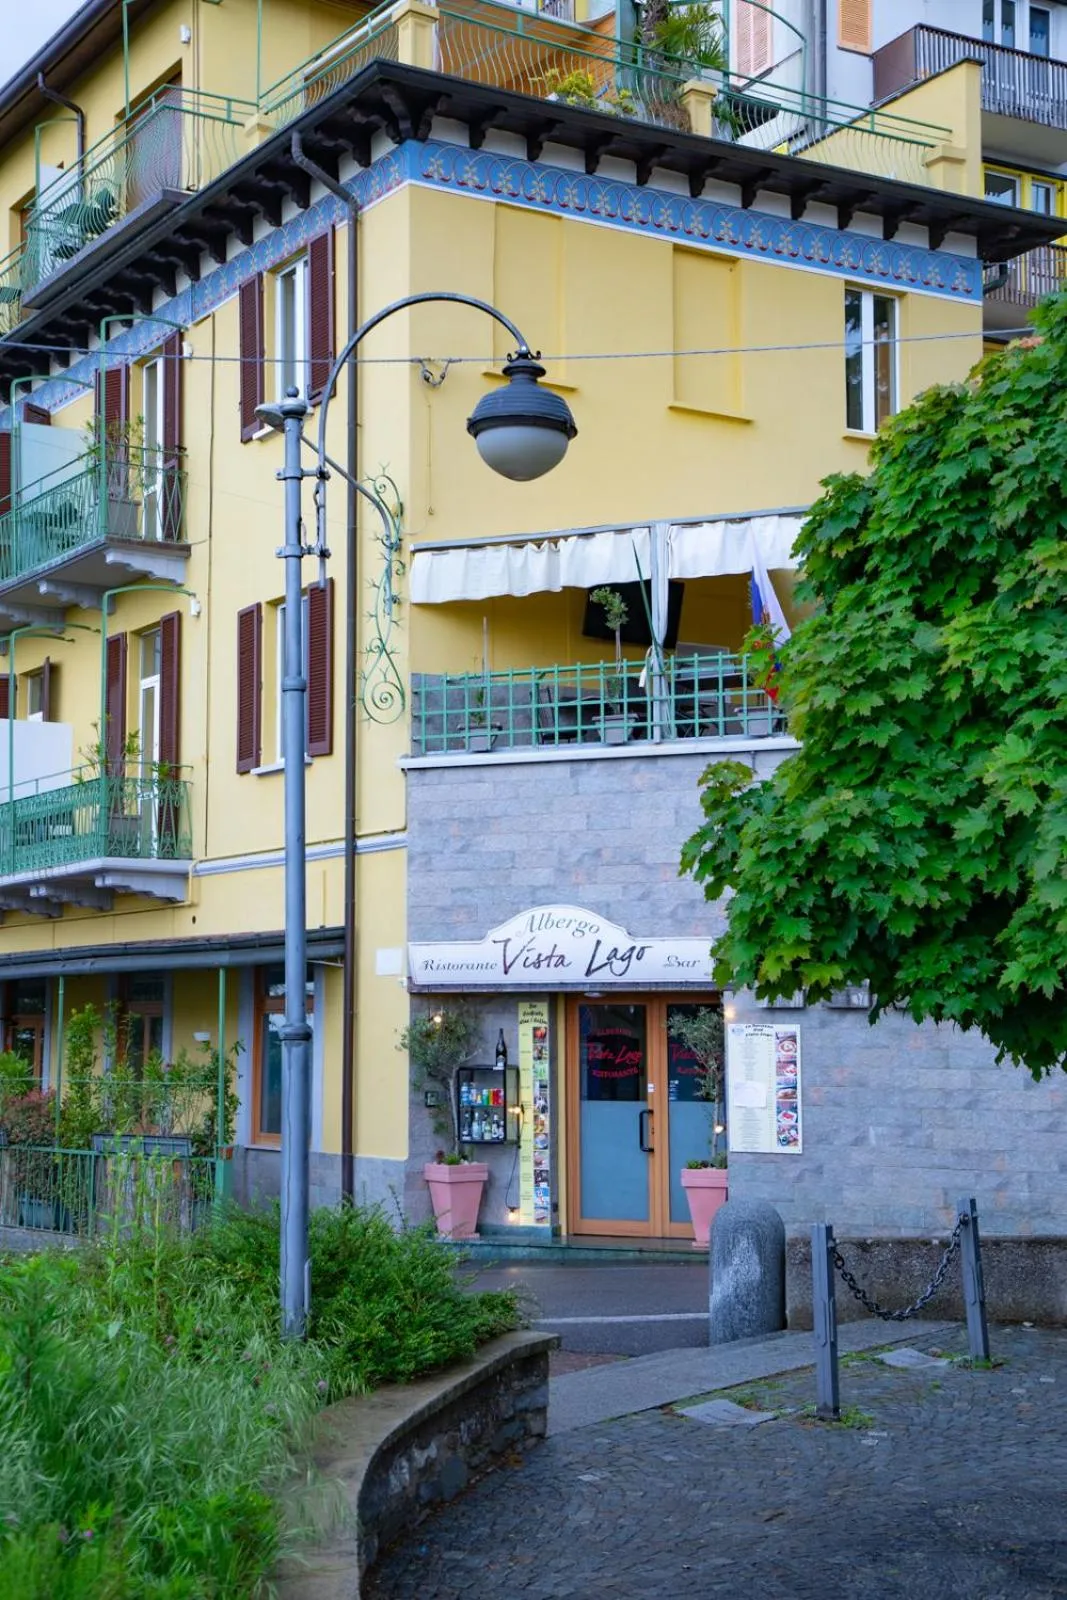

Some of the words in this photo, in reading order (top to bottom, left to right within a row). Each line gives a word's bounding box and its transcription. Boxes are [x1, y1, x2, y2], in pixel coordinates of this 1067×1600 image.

[518, 912, 601, 939] Albergo
[422, 959, 498, 971] Ristorante
[492, 936, 572, 976] Vista
[584, 939, 654, 978] Lago
[663, 955, 701, 969] Bar
